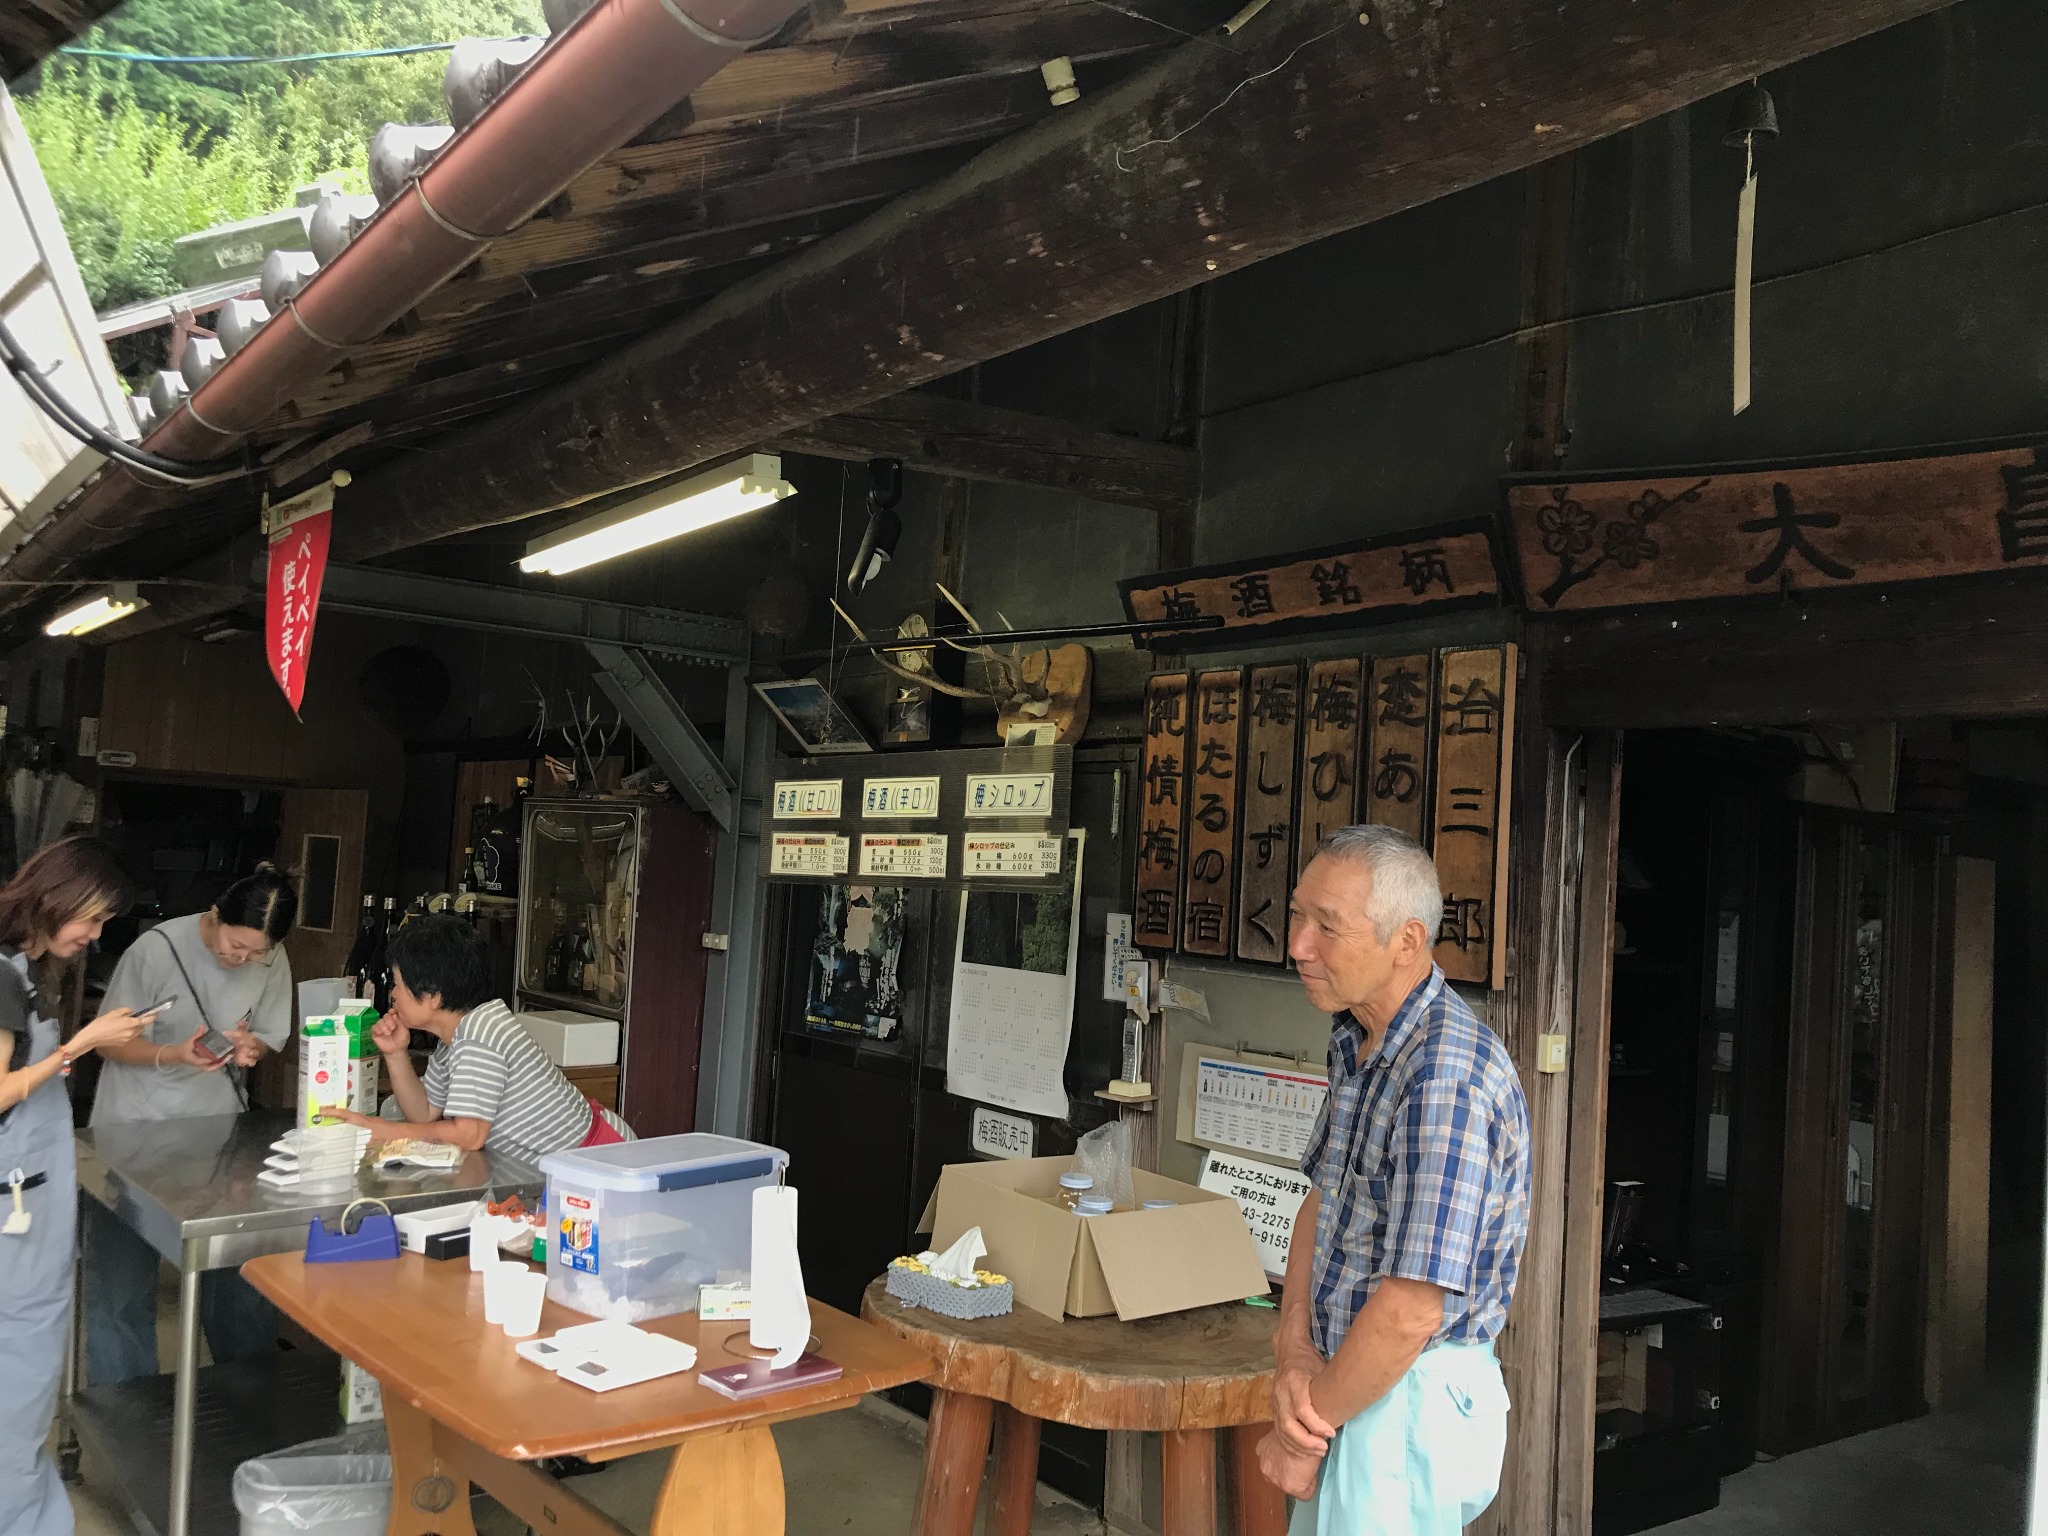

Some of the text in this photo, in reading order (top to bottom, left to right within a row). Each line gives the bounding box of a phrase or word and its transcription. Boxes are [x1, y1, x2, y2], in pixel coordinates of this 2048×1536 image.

[294, 532, 312, 657] ペイペイ
[1161, 547, 1454, 620] 梅酒銘柄
[280, 560, 296, 698] 使えます。
[1309, 673, 1359, 841] 梅ひ
[975, 780, 1045, 807] 梅シロップ
[1138, 684, 1184, 936] 純情梅酒
[1248, 677, 1296, 946] 梅しずく
[1186, 684, 1238, 943] ほたるの宿
[1436, 678, 1499, 951] 治三郎
[929, 857, 942, 865] 120g
[968, 842, 1015, 850] 梅シロップの仕込み
[1041, 852, 1057, 861] 330g
[1040, 861, 1057, 870] 330g
[318, 1050, 328, 1068] 焼酎
[978, 1115, 1029, 1154] 梅酒販売中
[1208, 1160, 1310, 1196] 離れたところにおります
[1230, 1185, 1277, 1206] ご用の方は
[1242, 1207, 1291, 1230] 43-2275
